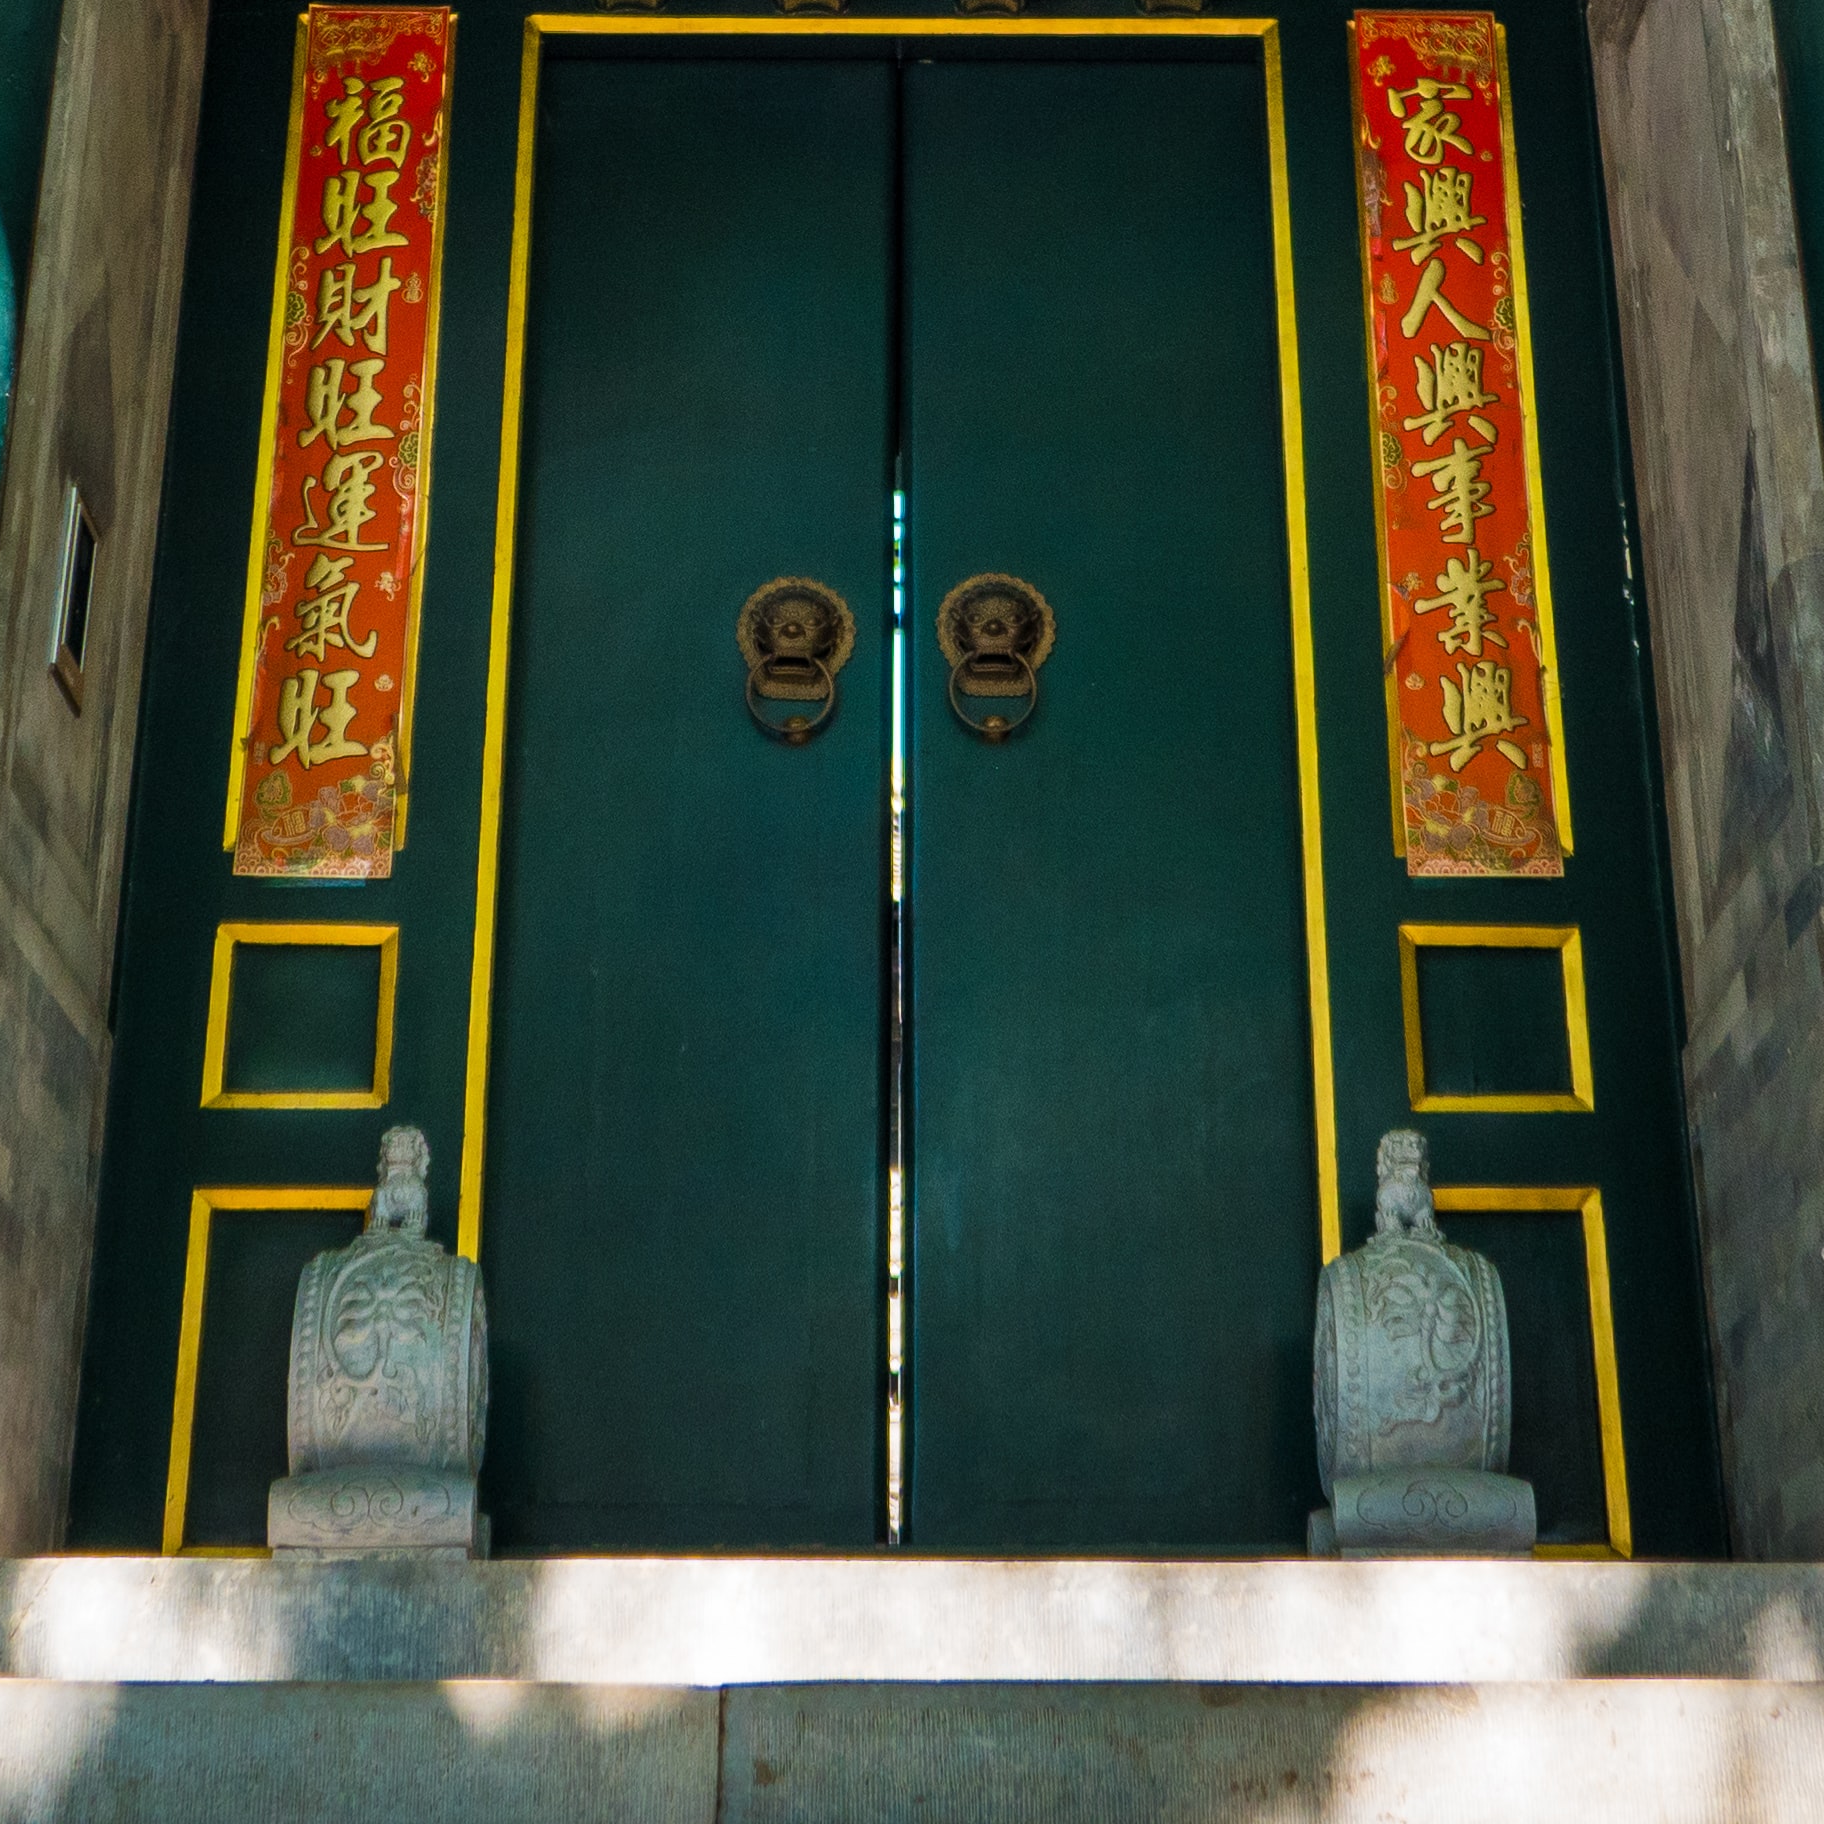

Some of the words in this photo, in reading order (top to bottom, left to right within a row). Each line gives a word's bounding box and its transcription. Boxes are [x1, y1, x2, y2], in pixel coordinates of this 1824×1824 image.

[268, 76, 412, 771] 福旺財旺運氣旺
[1386, 78, 1529, 773] 家興人興事業興
